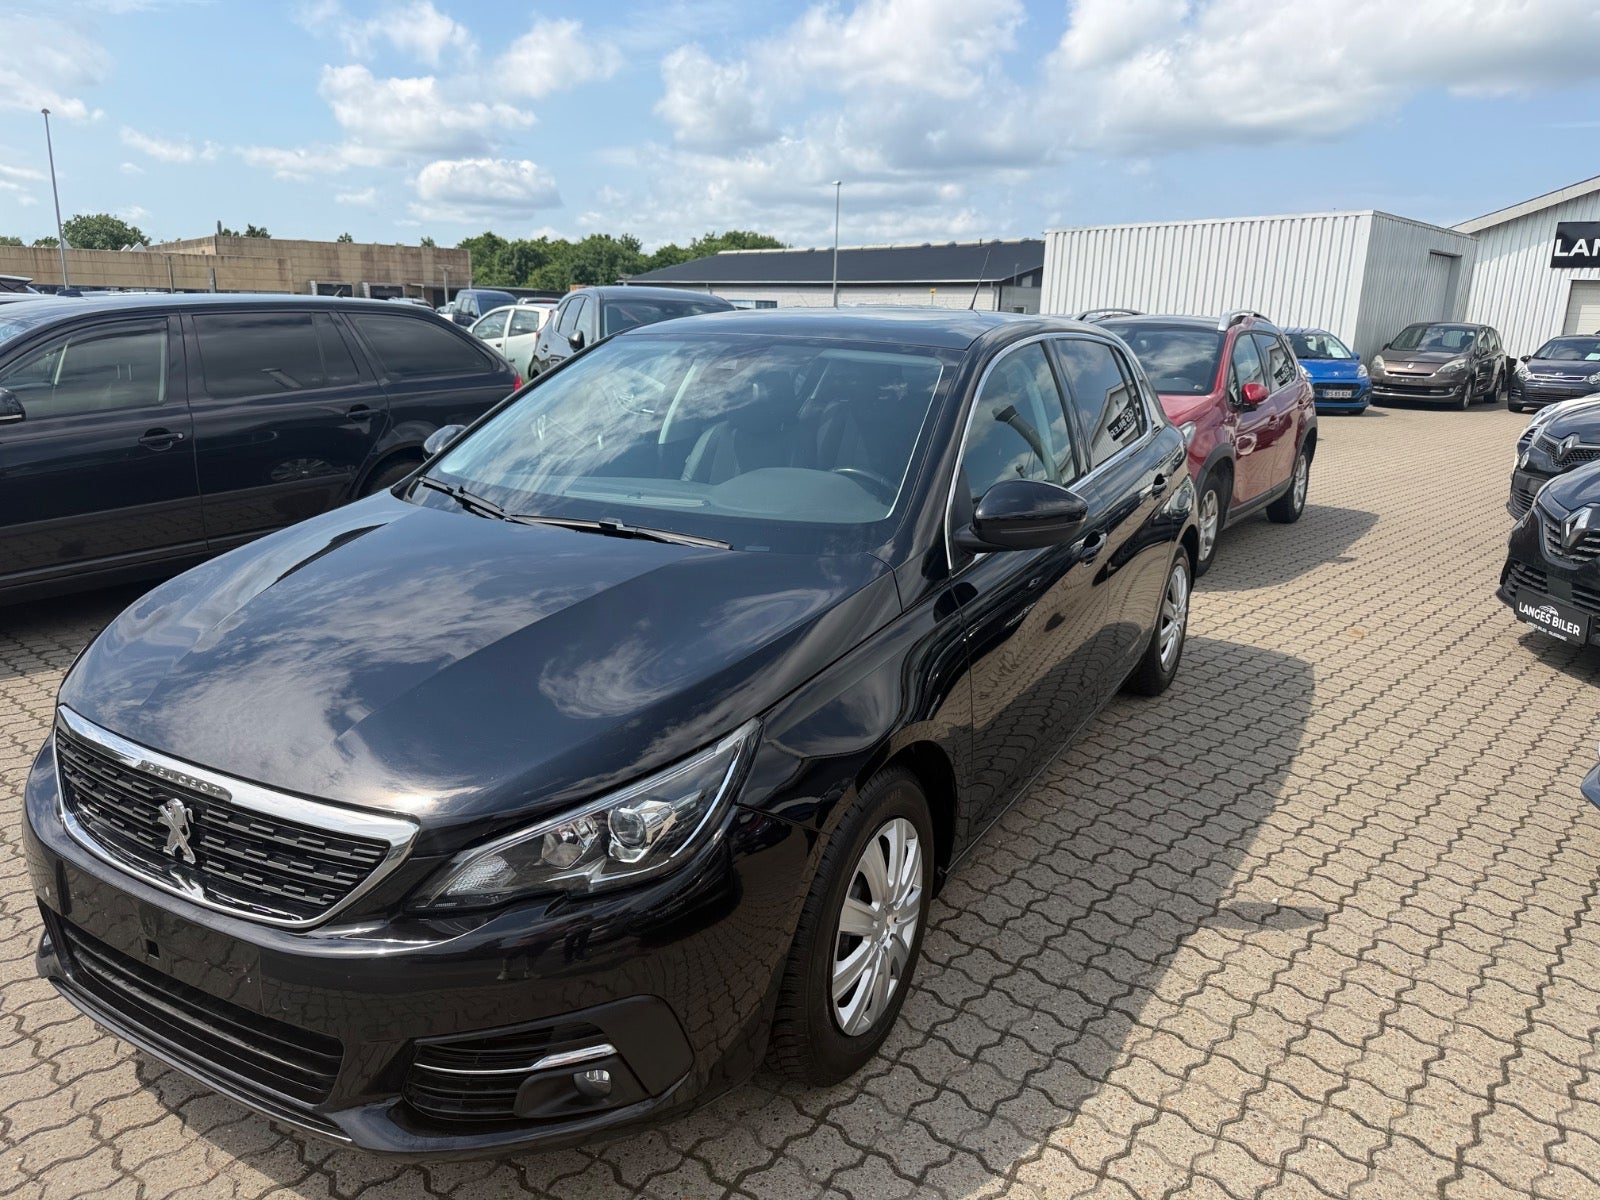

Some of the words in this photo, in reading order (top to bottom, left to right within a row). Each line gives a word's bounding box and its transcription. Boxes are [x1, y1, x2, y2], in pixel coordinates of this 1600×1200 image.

[1518, 601, 1552, 625] LANGES
[1551, 616, 1581, 637] BILER
[147, 763, 221, 796] PEUGEOT
